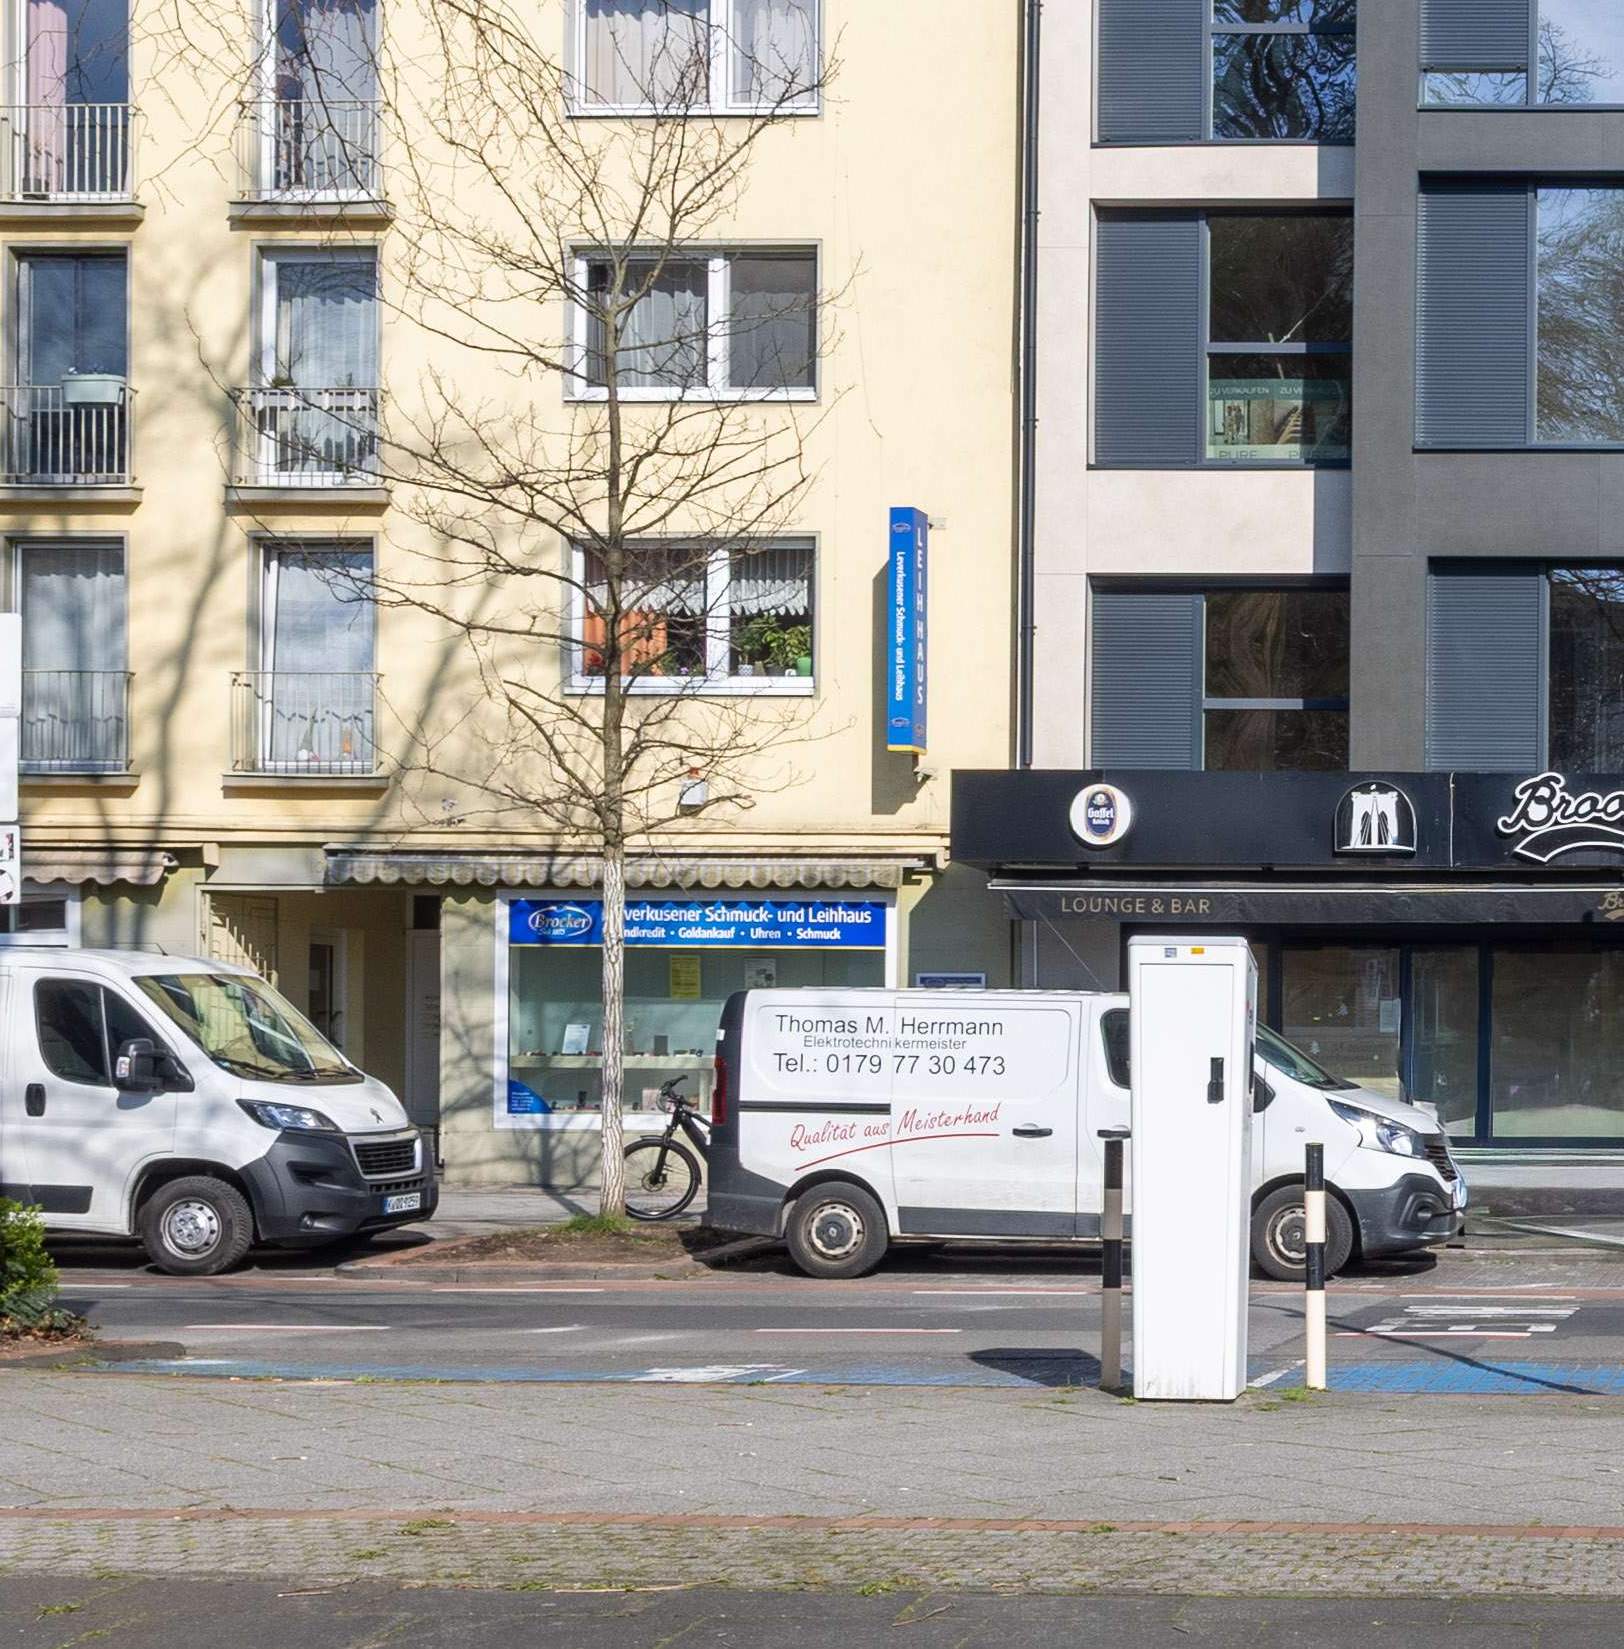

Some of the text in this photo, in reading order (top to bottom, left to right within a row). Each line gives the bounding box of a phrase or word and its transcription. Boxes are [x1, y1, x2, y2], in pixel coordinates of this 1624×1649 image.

[1221, 387, 1269, 395] VERKAUFEN
[896, 647, 905, 663] und
[1061, 897, 1211, 914] LOUNGE & BAR
[624, 906, 872, 924] verkusener Schmuck- und Leihhaus
[678, 927, 736, 939] Goldankauf
[750, 928, 781, 939] Uhren
[796, 928, 841, 940] Schmuck
[775, 1014, 1004, 1036] Thomas M. Herrmann
[773, 1053, 1006, 1076] Tel.: 0179 77 30 473
[790, 1102, 1001, 1151] Qualität aus Meisterhand
